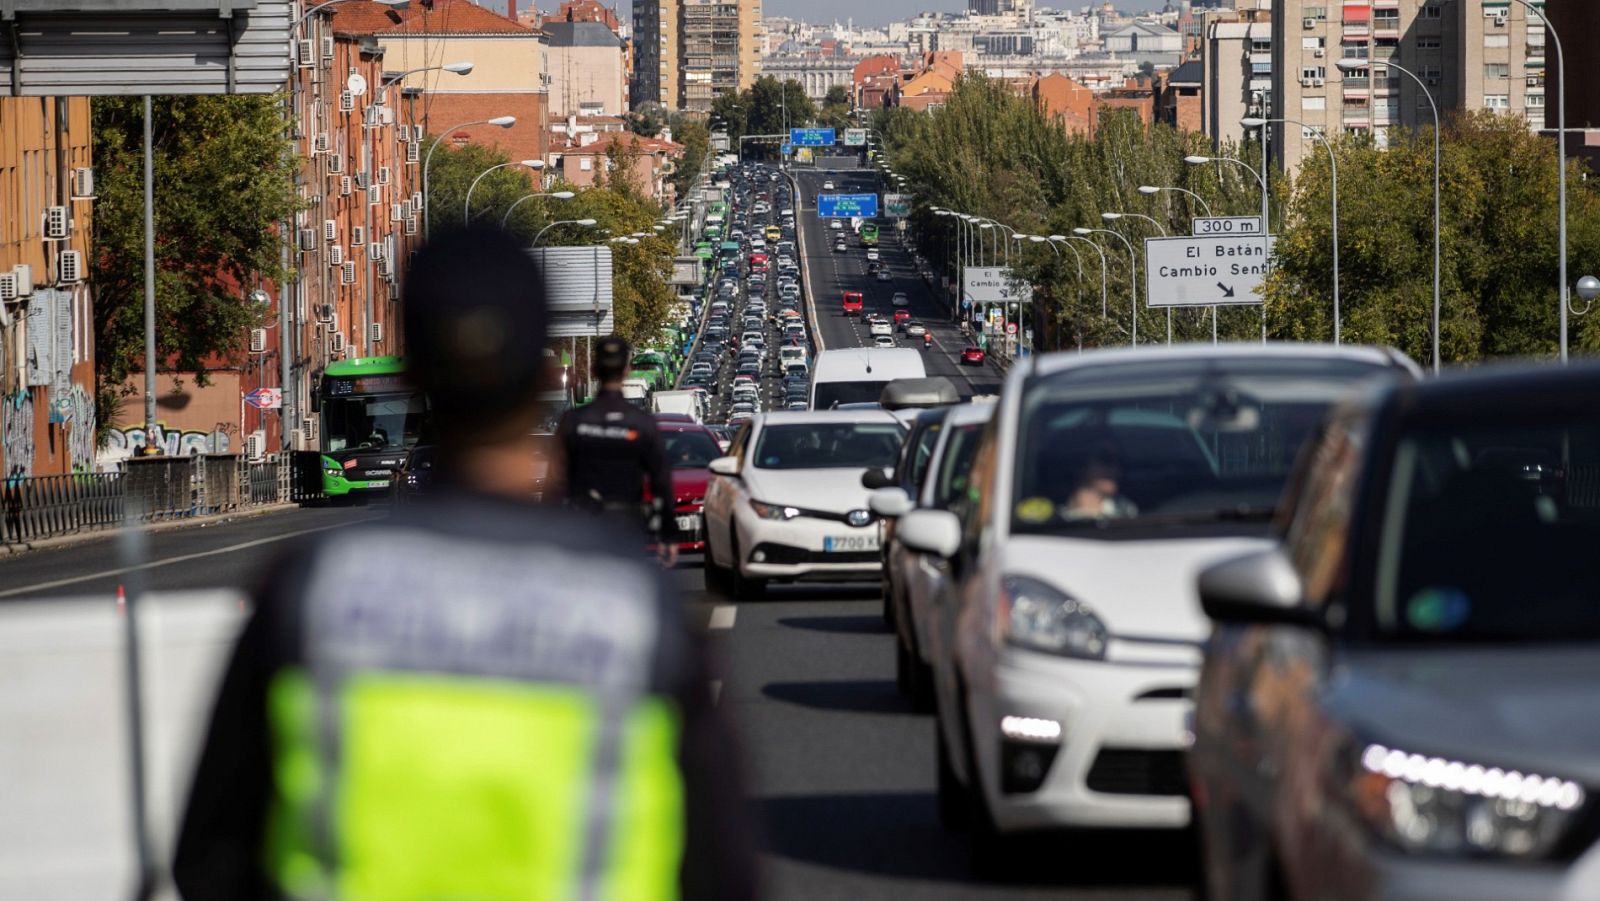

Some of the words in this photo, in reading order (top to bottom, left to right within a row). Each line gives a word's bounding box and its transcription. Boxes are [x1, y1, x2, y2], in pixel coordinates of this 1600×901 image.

[1202, 220, 1233, 232] 300
[1240, 221, 1253, 231] m
[1186, 246, 1200, 258] El
[1215, 243, 1263, 257] Batán
[1159, 264, 1217, 277] Cambio
[832, 536, 864, 548] 7700
